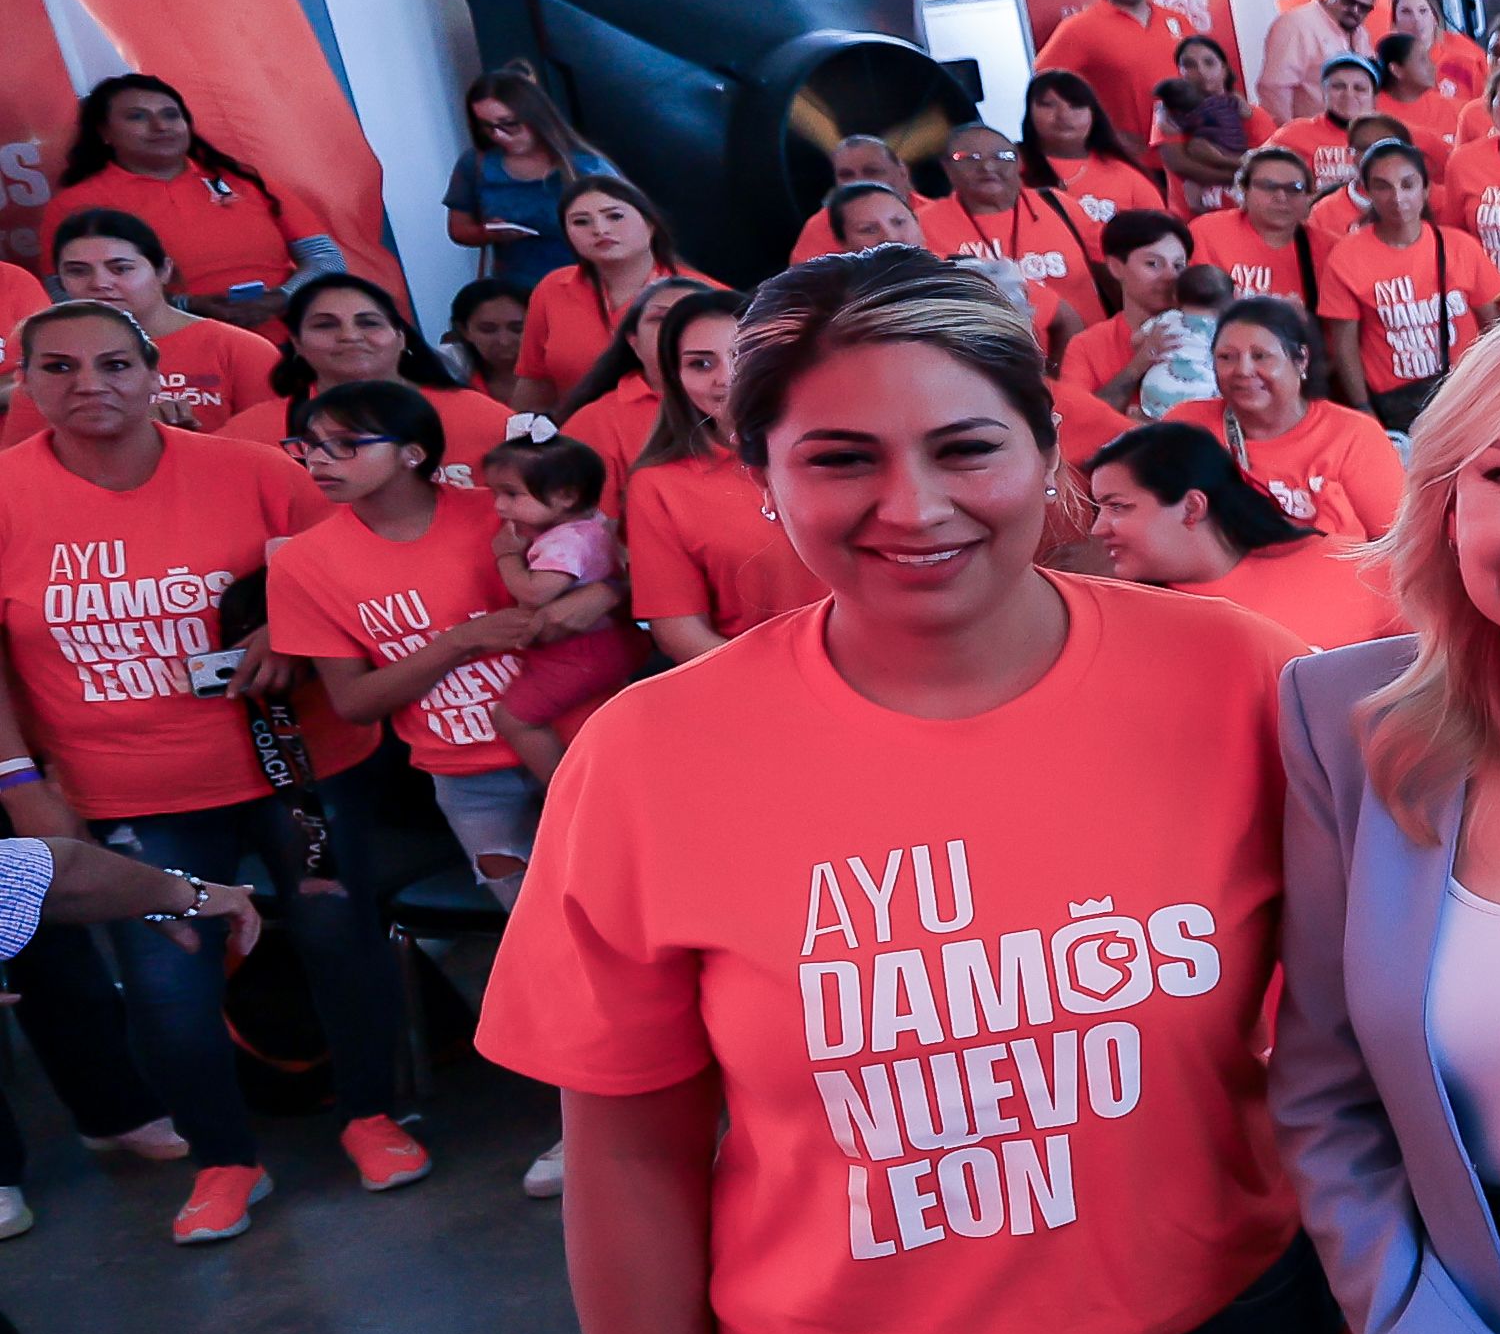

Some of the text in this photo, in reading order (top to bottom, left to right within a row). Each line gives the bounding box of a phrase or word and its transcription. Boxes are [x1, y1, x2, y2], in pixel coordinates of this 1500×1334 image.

[1231, 263, 1272, 291] AYU
[1374, 275, 1415, 307] AYU
[50, 540, 126, 581] AYU
[45, 567, 236, 624] DAMOS
[357, 589, 431, 640] AYU
[49, 617, 210, 663] NUEVO
[427, 701, 499, 746] LEO
[252, 719, 294, 787] COACH
[800, 839, 975, 956] AYU
[798, 895, 1222, 1062] DAMOS
[812, 1020, 1143, 1162] NUEVO
[847, 1134, 1078, 1261] LEON
